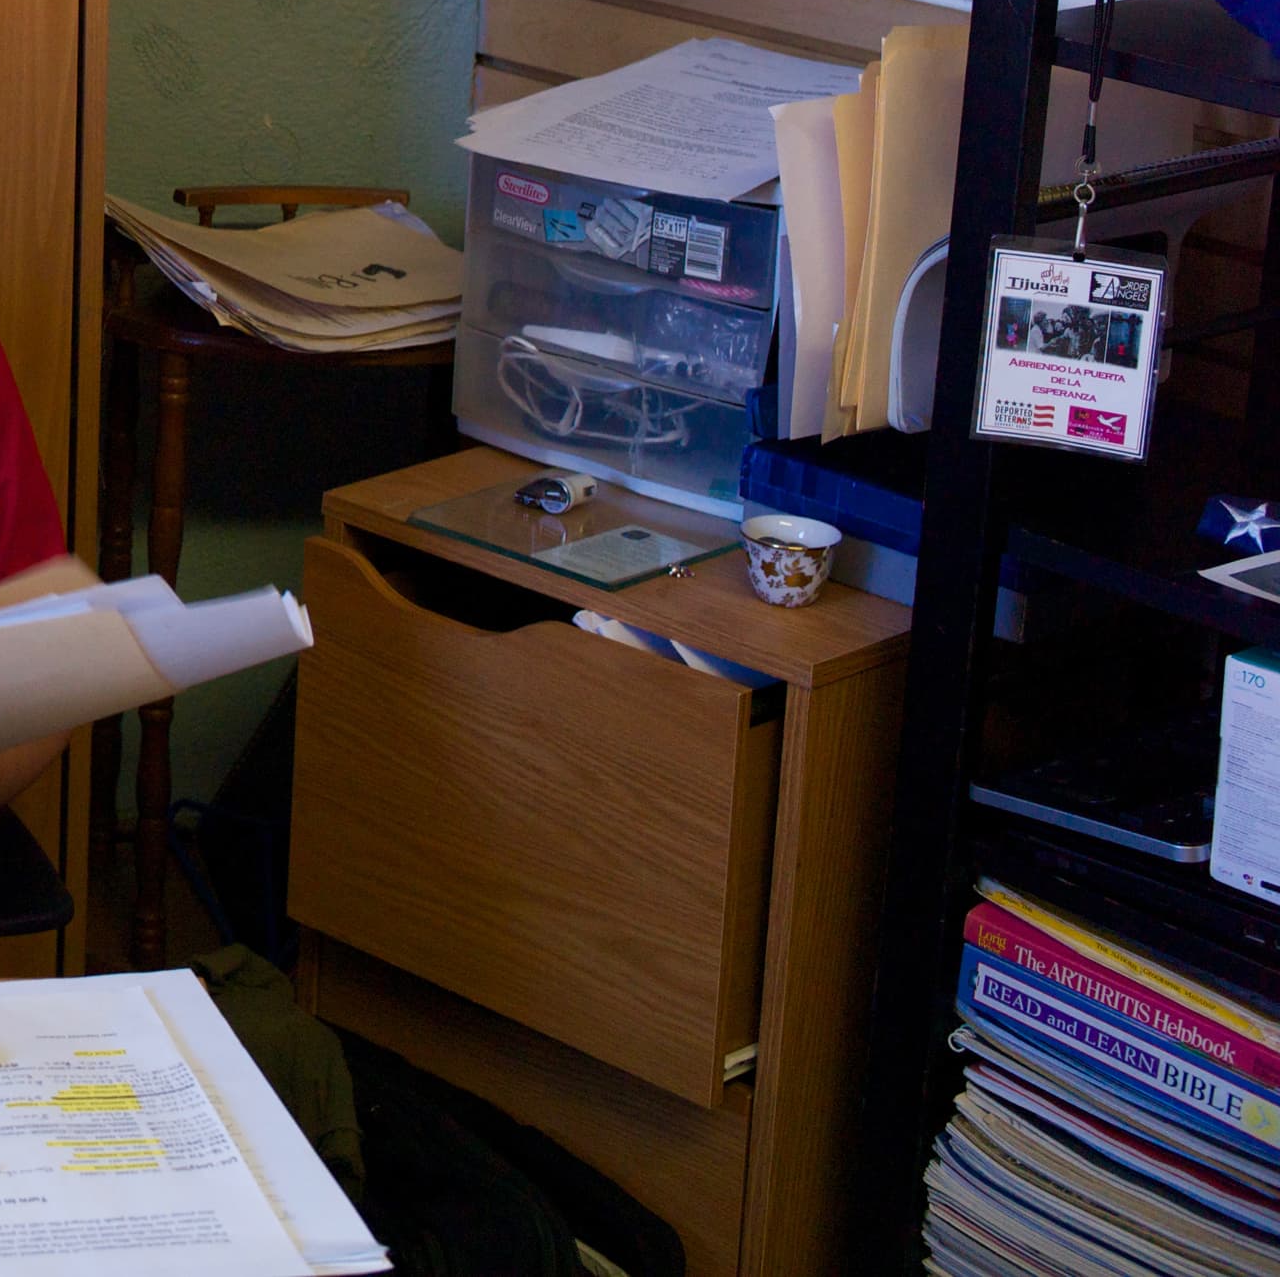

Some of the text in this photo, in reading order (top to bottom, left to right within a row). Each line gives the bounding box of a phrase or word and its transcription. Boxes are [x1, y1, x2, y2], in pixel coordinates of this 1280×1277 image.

[503, 178, 544, 200] Sterilite
[1005, 276, 1069, 295] Tijuana
[1009, 358, 1126, 383] ABRIENDO LA PUERTA
[1051, 376, 1081, 388] DE LA
[1032, 385, 1097, 403] ESPERANZA
[995, 405, 1032, 418] DEPORTED
[995, 414, 1032, 426] VETERANS
[978, 924, 1008, 948] Lorig
[1015, 943, 1237, 1065] The ARTHRITIS Helpbook
[987, 977, 1244, 1122] READ and LEARN BIBLE
